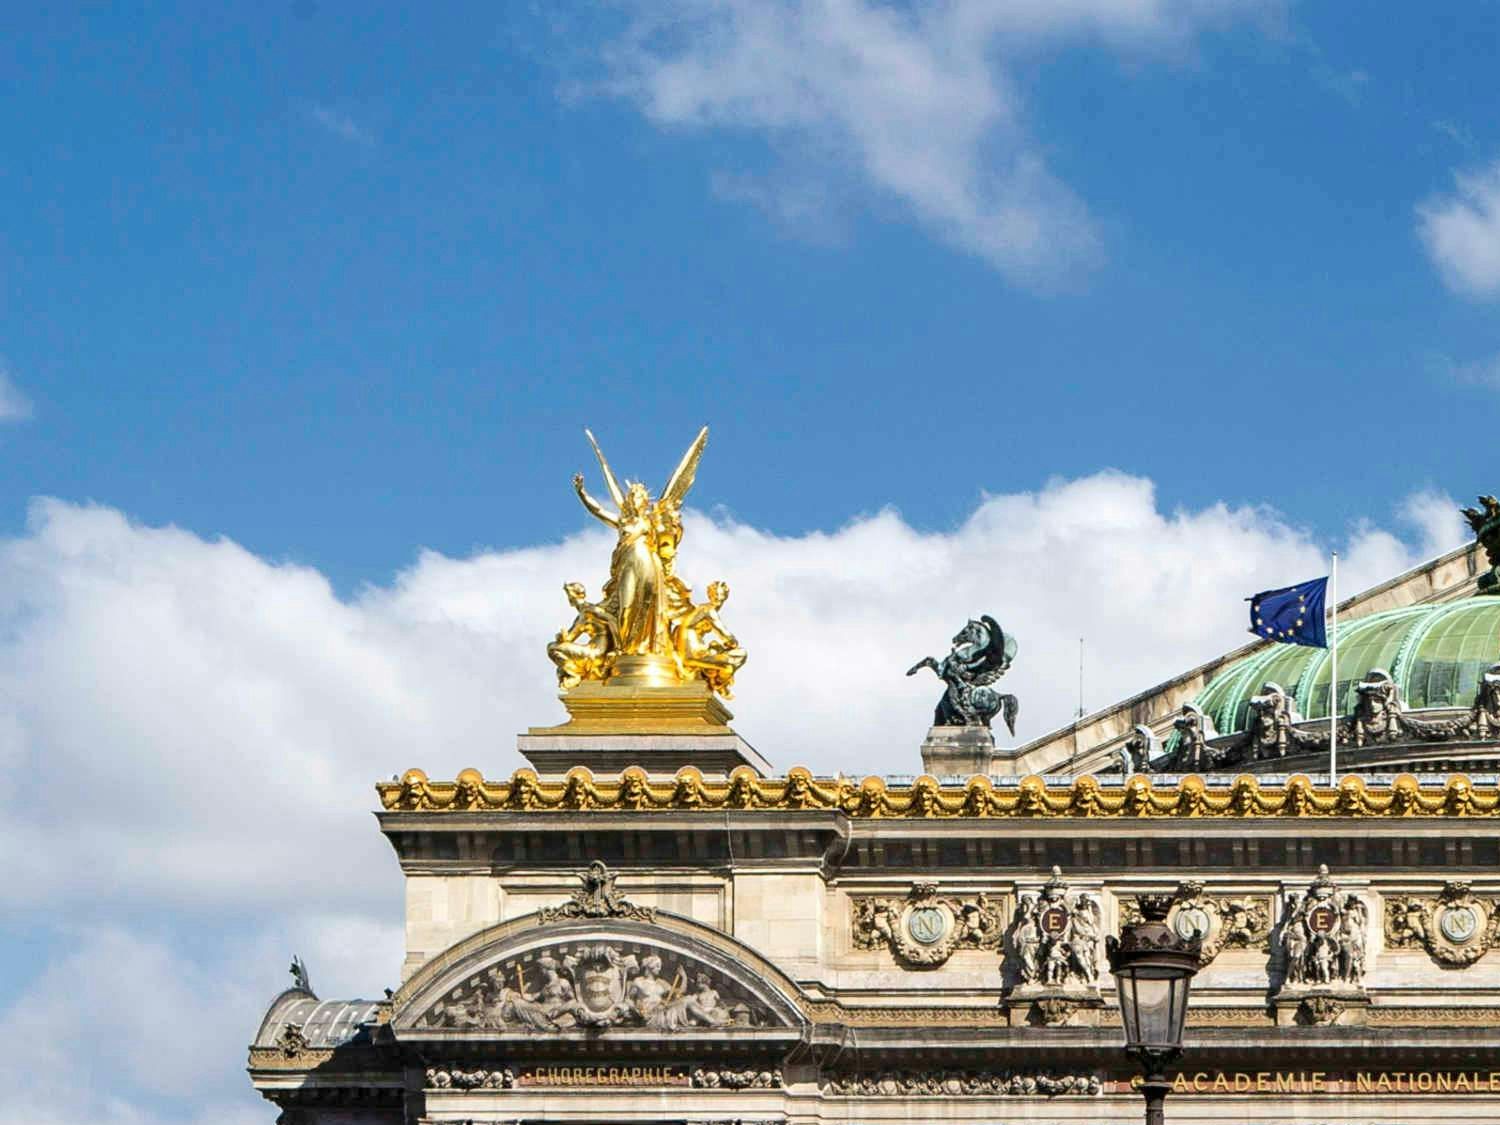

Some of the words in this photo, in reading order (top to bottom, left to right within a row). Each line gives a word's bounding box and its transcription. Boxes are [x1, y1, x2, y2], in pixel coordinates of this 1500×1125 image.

[917, 915, 935, 934] N
[1048, 912, 1061, 929] E
[1316, 912, 1329, 929] E
[1449, 915, 1466, 934] N
[534, 1066, 673, 1085] CHOREGRAPHIE
[1172, 1072, 1326, 1093] ACADEMIE
